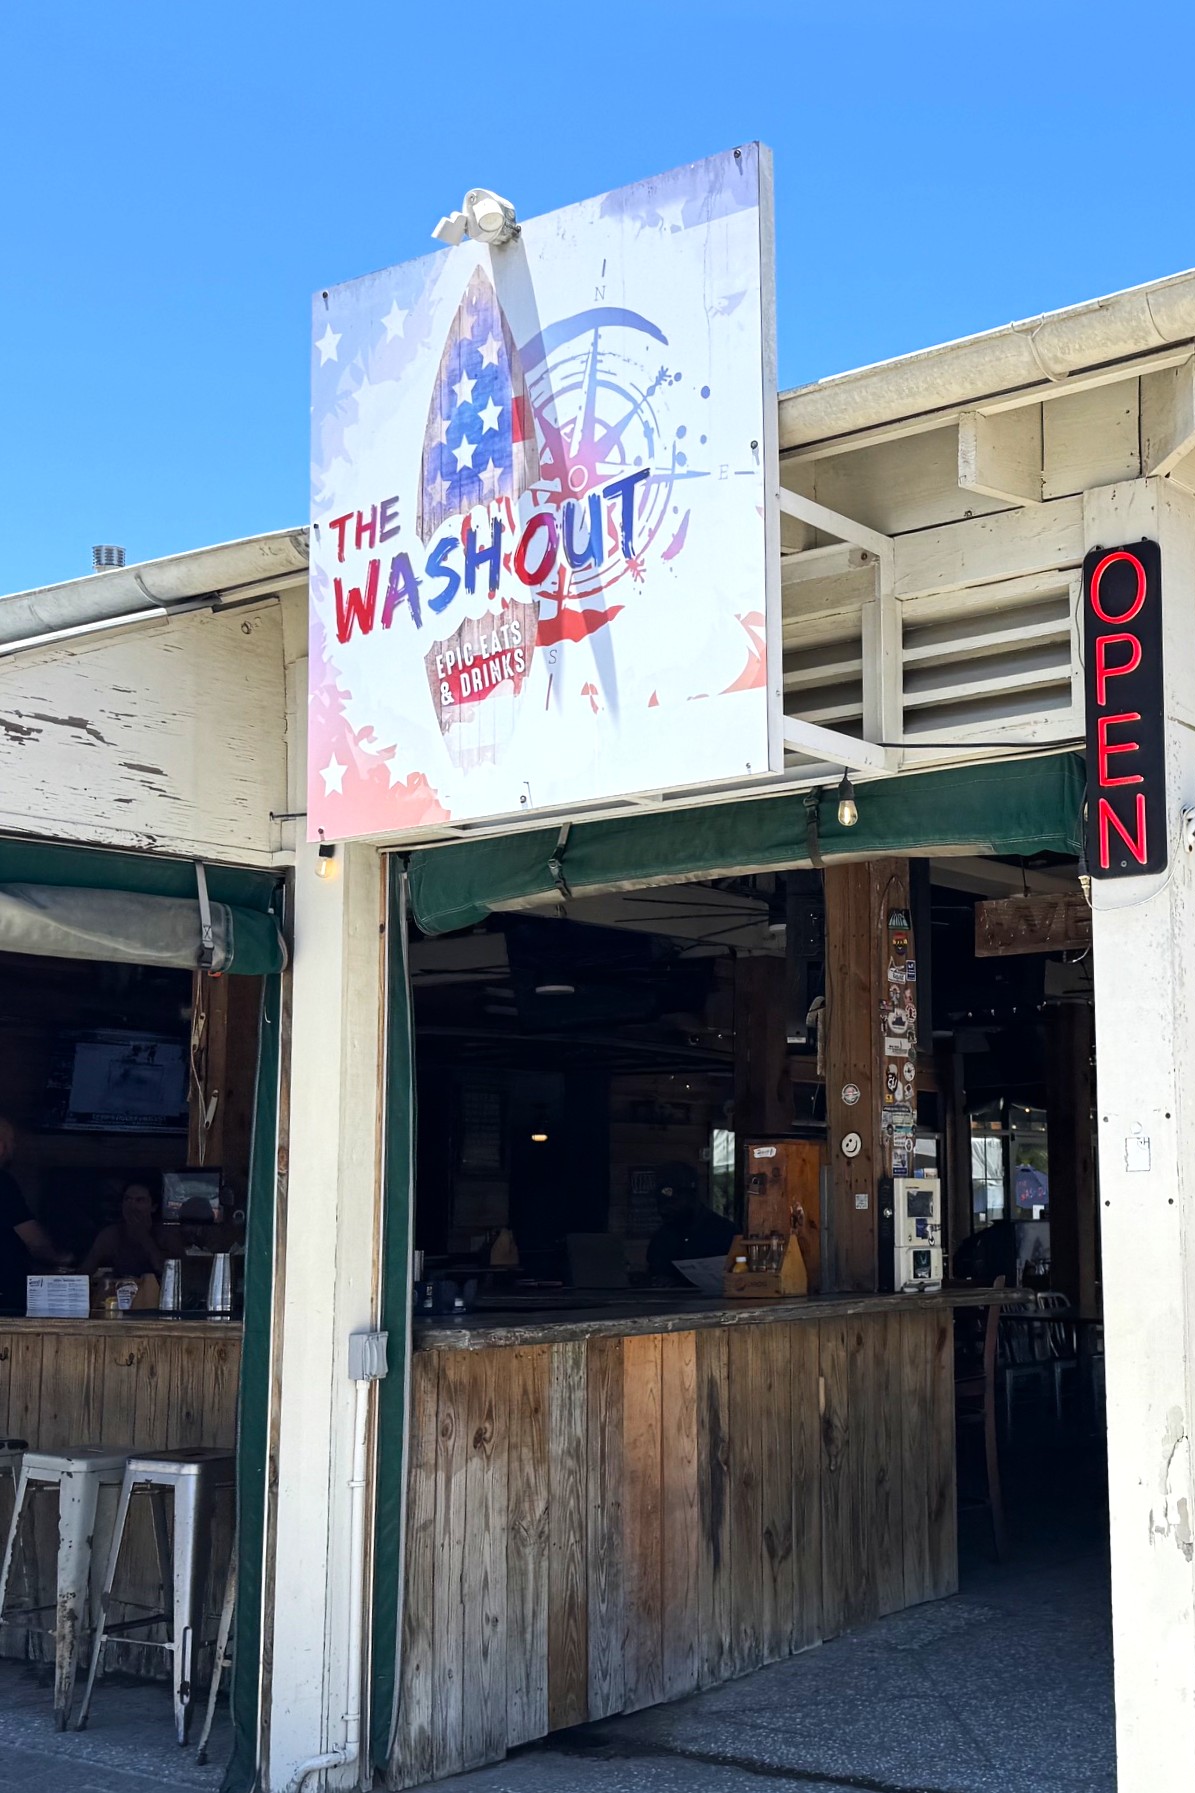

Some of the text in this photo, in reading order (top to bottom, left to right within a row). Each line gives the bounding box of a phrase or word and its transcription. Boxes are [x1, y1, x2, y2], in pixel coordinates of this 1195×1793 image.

[329, 496, 401, 563] THE
[436, 620, 521, 679] EPIC EATS
[440, 648, 525, 706] & DRINKS
[1090, 551, 1147, 869] OPEN
